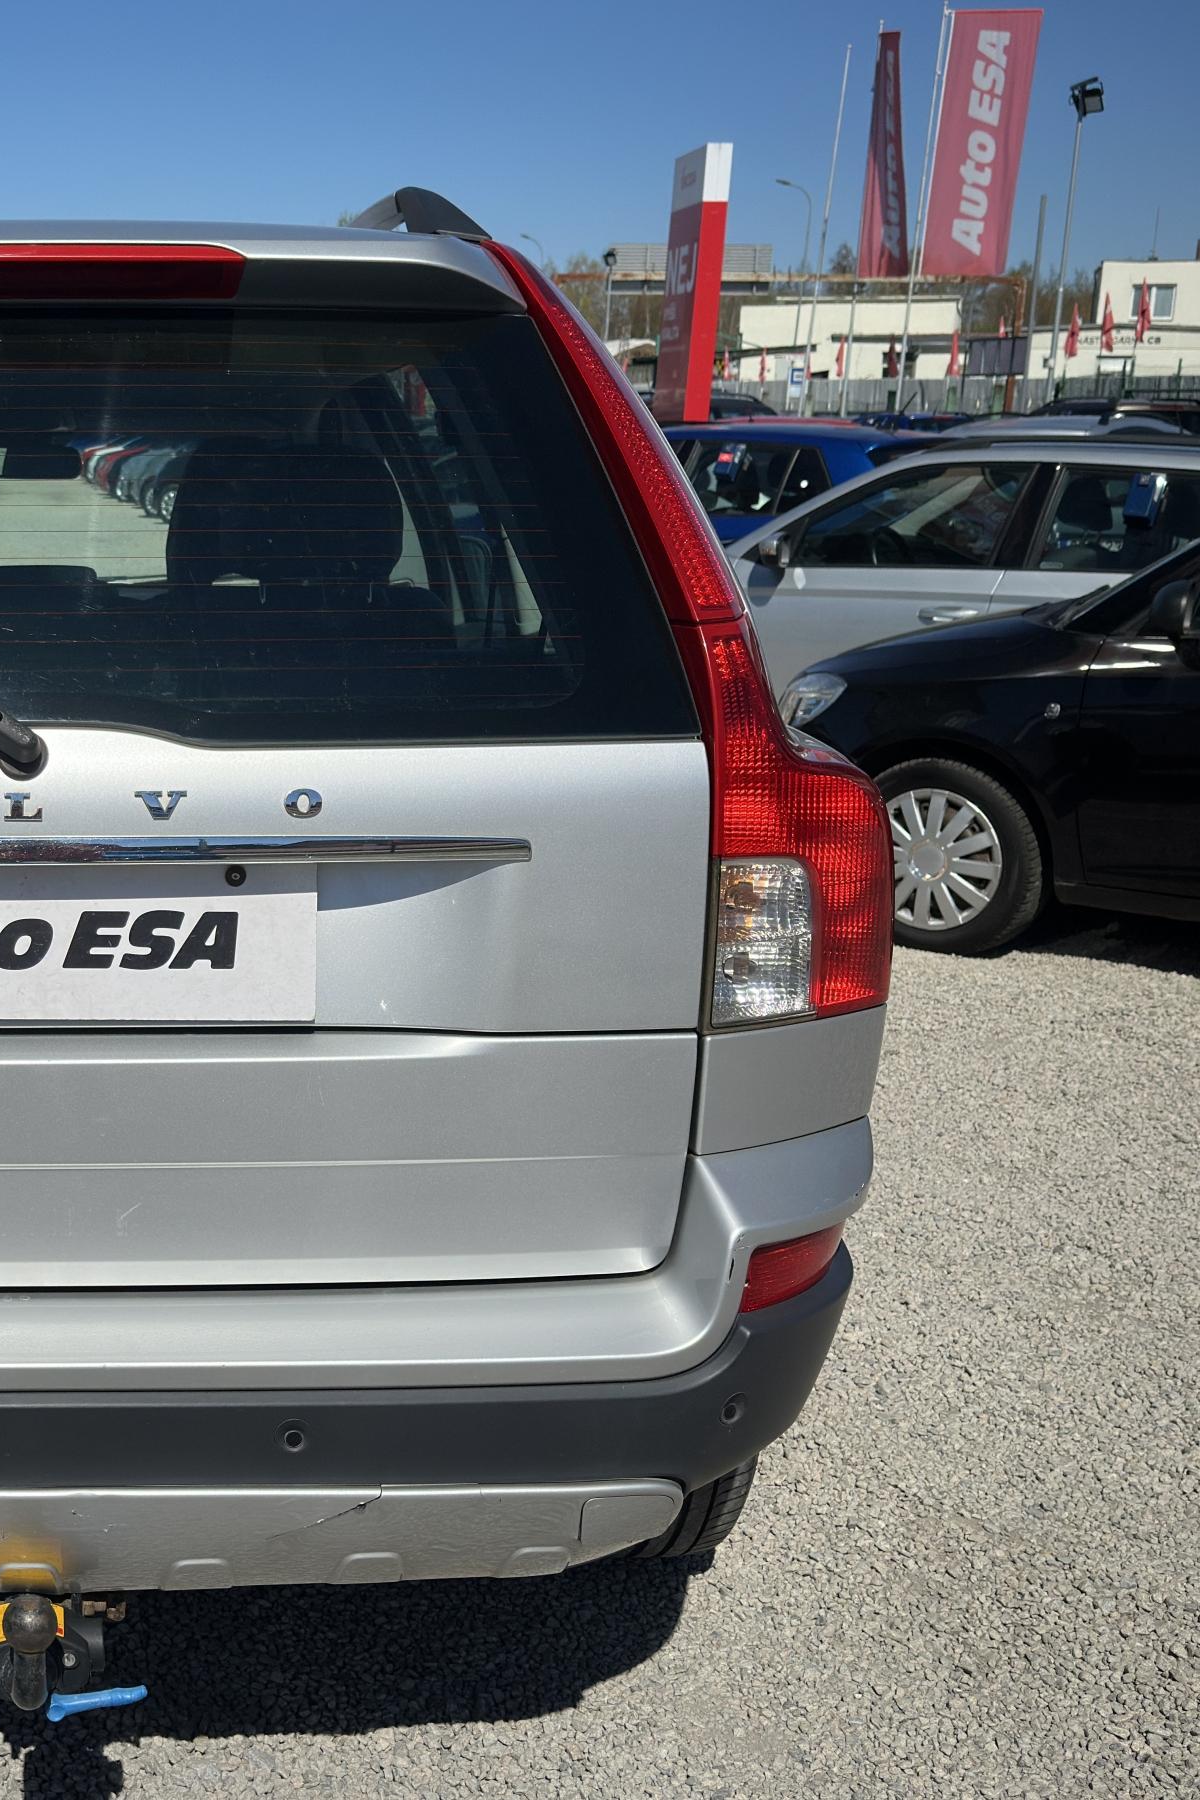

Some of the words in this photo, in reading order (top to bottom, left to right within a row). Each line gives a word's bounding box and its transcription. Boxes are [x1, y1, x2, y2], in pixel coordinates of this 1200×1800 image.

[967, 29, 1012, 128] ESA
[950, 129, 997, 257] Auto
[665, 241, 698, 297] NEJ
[62, 909, 240, 970] ESA
